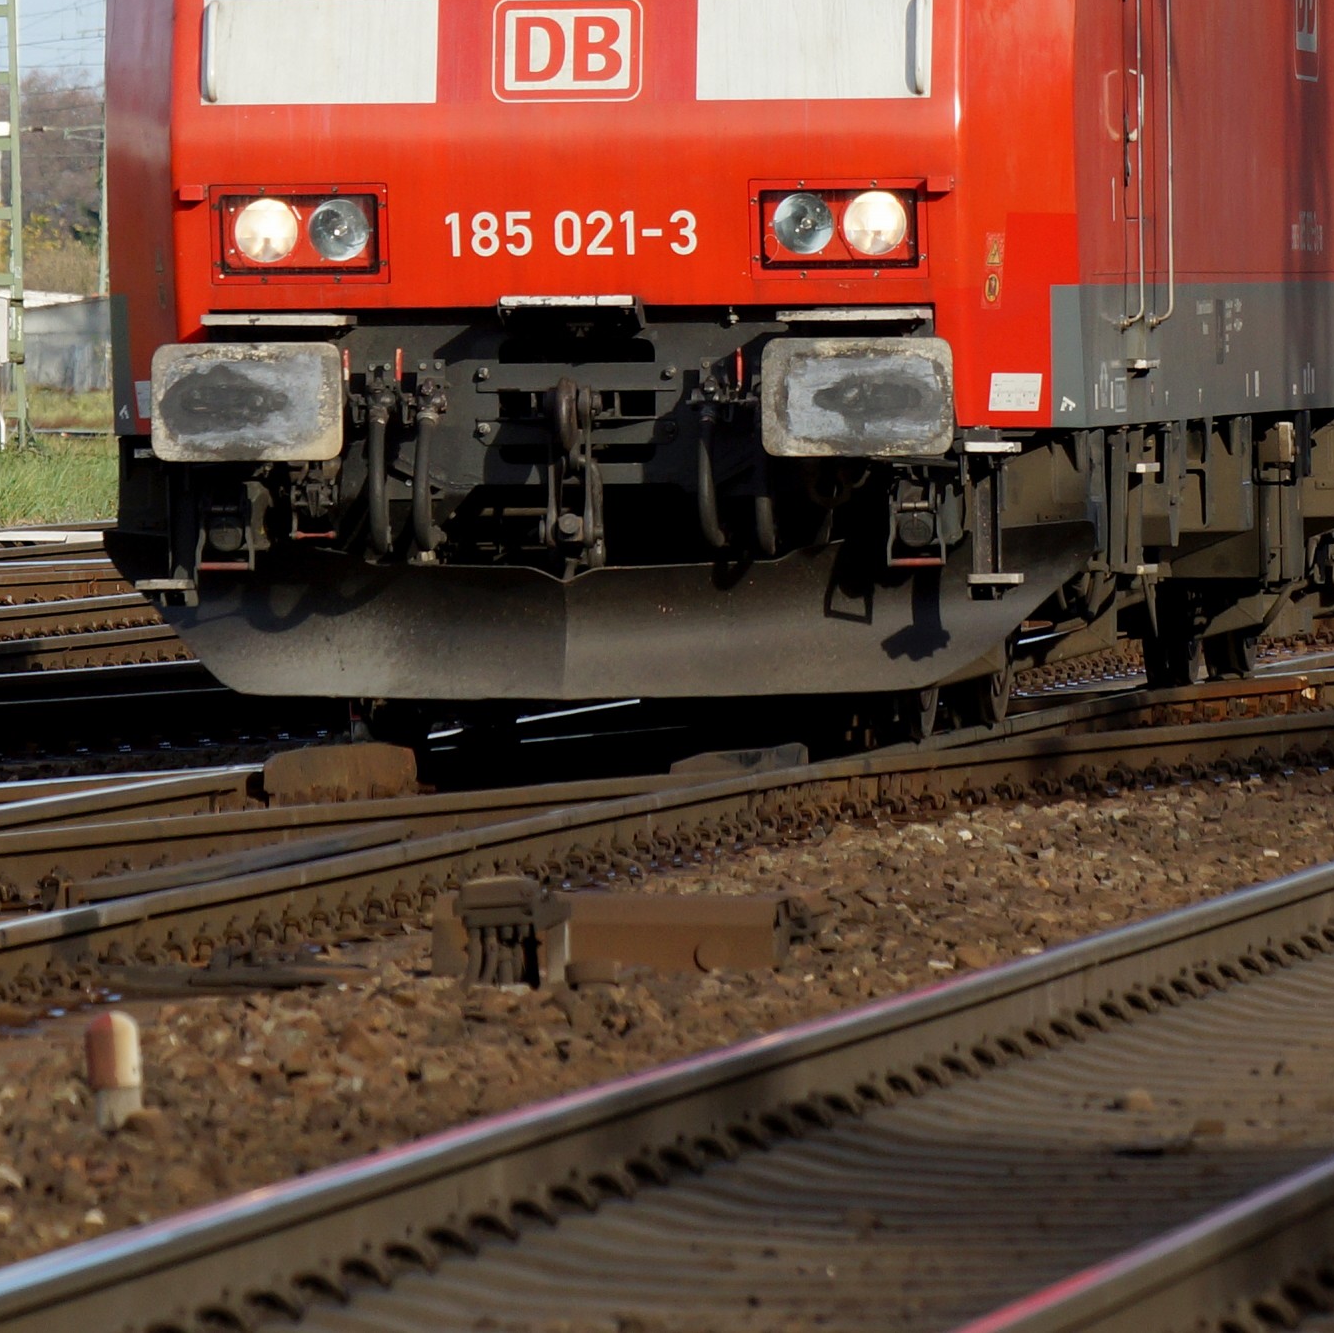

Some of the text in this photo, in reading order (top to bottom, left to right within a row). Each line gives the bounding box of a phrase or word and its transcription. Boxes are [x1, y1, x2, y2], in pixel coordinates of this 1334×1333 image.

[514, 15, 623, 83] DB
[445, 209, 698, 257] 185 021-3
